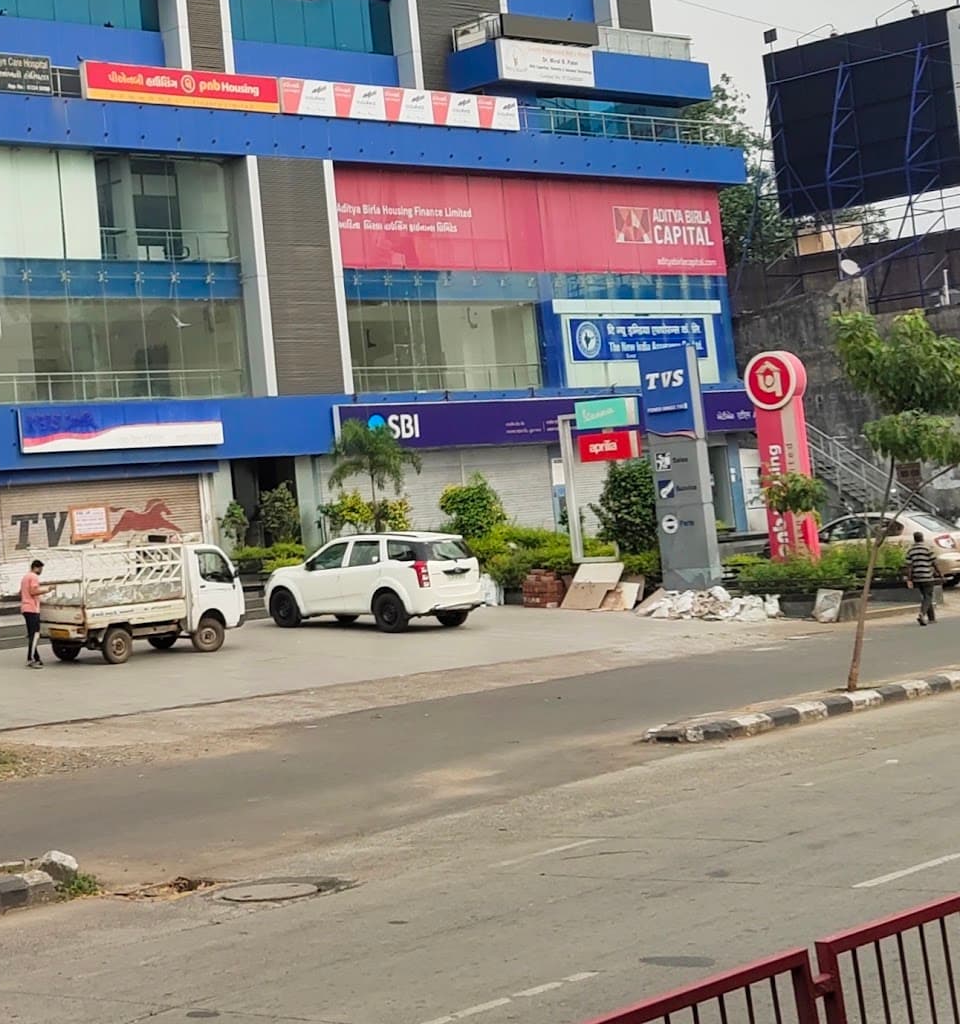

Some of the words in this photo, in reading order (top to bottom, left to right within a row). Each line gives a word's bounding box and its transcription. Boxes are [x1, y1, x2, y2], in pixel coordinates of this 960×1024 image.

[221, 81, 260, 97] Housing
[337, 202, 362, 215] Aditya
[362, 204, 381, 215] Birla
[382, 205, 413, 218] Housing
[414, 207, 443, 217] Finance
[445, 208, 472, 218] Limited
[653, 208, 683, 223] ADITYA
[685, 210, 712, 224] BIRLA
[654, 226, 715, 246] CAPITAL
[645, 369, 684, 391] TVS
[388, 414, 420, 439] SBI
[11, 511, 70, 550] TV
